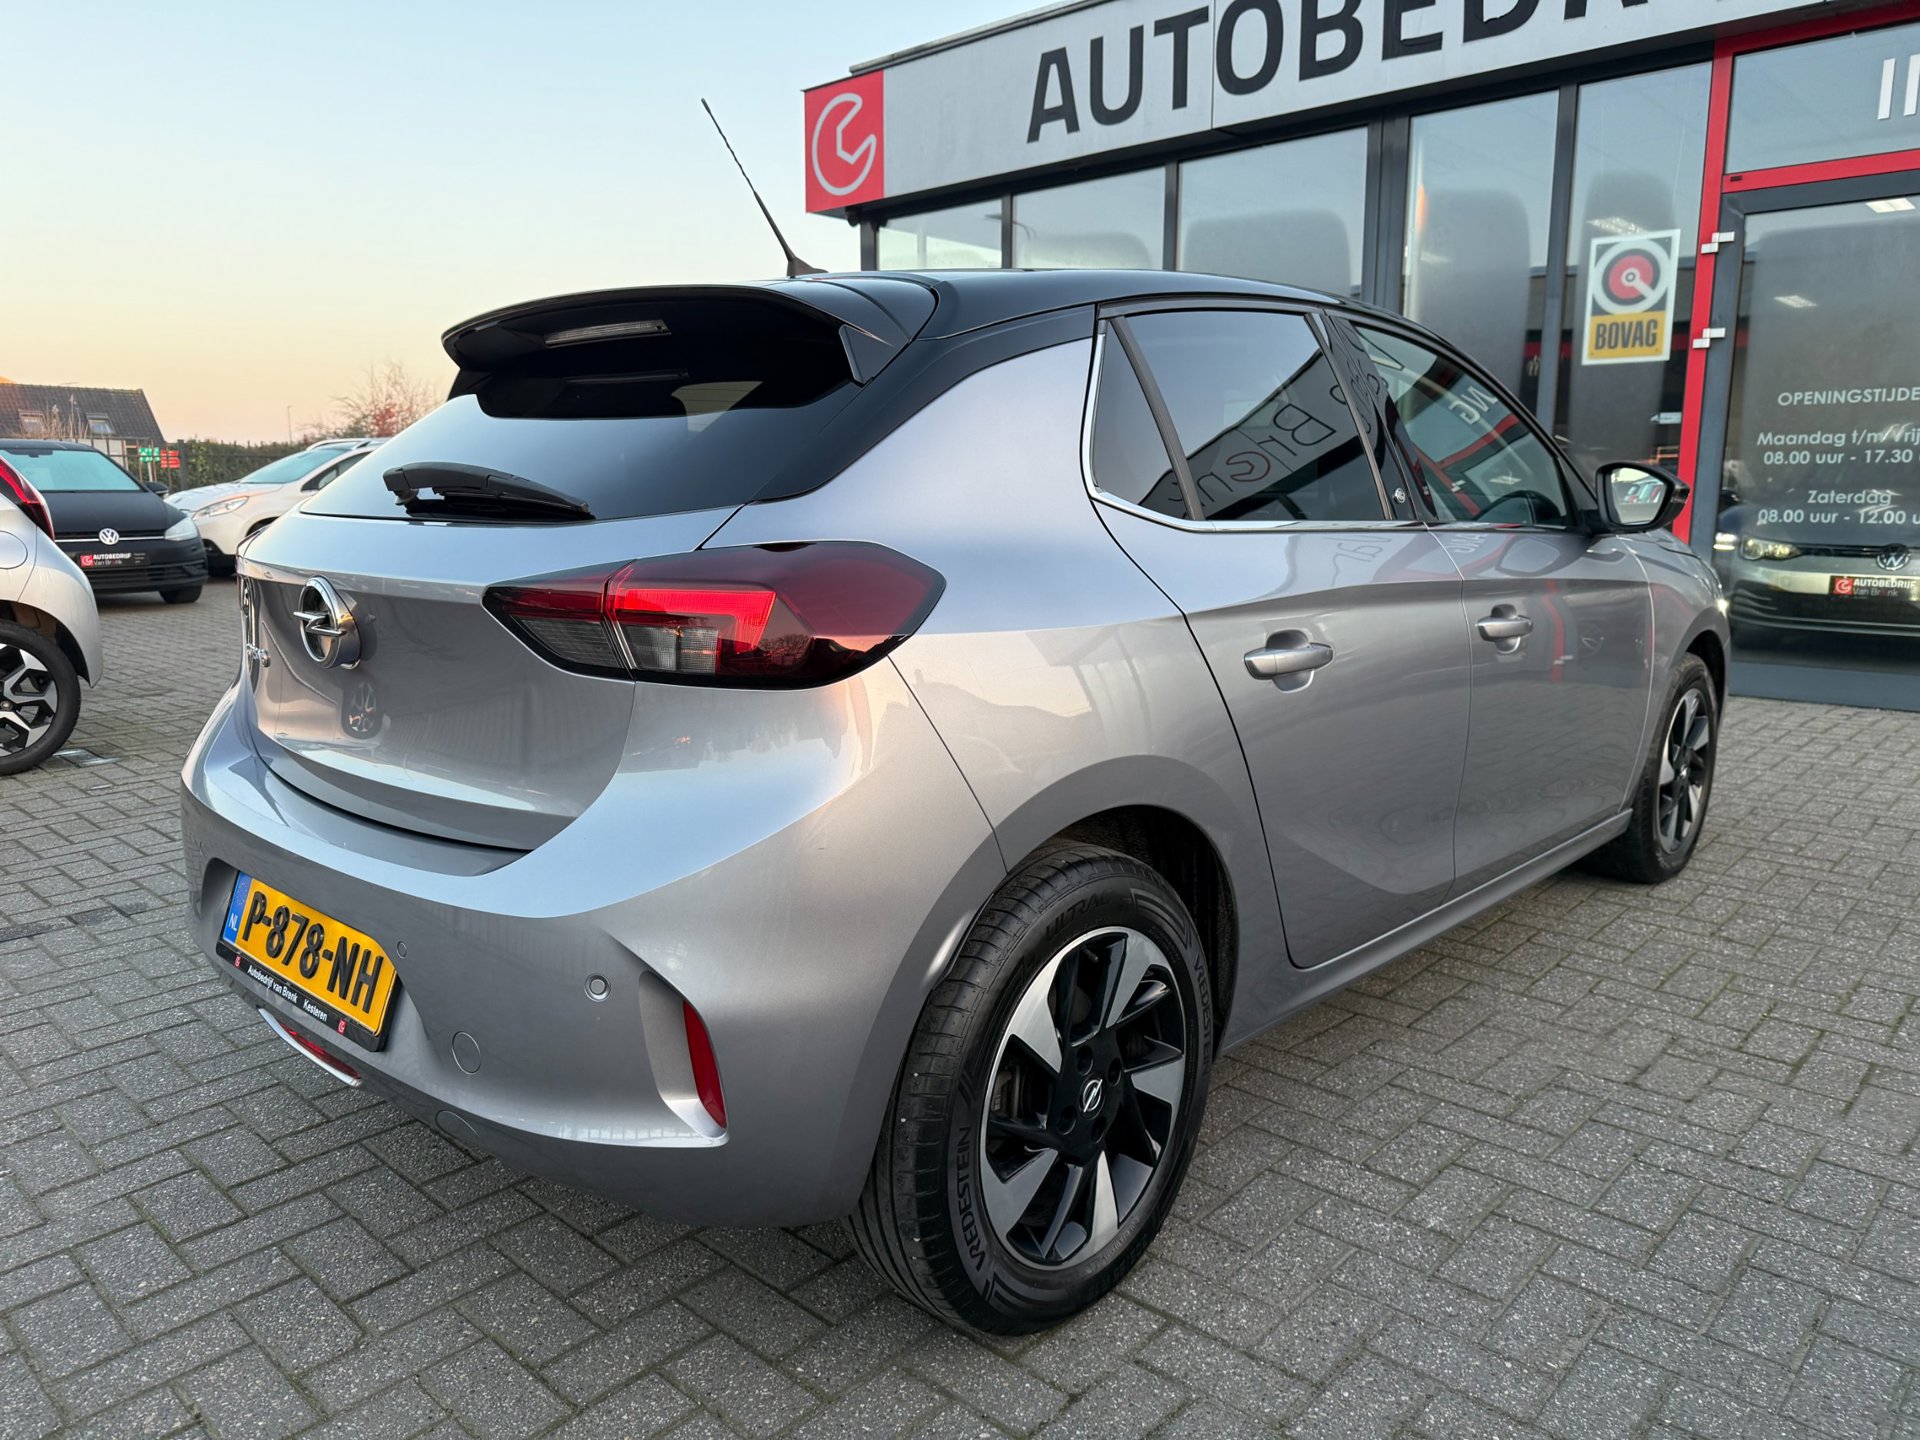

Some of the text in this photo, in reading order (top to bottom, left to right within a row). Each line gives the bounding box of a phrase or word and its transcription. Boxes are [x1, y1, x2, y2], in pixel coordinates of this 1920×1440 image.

[1027, 0, 1649, 144] AUTOBE
[1594, 319, 1659, 350] BOVAG
[1777, 387, 1920, 407] OPENINGSTIJDE
[1757, 431, 1846, 447] Maandag
[1851, 429, 1885, 446] t/m
[1764, 450, 1811, 465] 08.00
[1816, 453, 1845, 464] uur
[1864, 449, 1913, 463] 17.30
[1807, 490, 1892, 507] Zaterdag
[1757, 509, 1804, 524] 08.00
[1810, 512, 1839, 523] uur
[1859, 510, 1906, 524] 12.00
[1853, 578, 1917, 589] AUTOBEDRIJF
[1871, 587, 1898, 597] Brnk
[228, 912, 237, 931] NL
[242, 890, 384, 1014] P-878-NH
[247, 964, 274, 989] Autobedrijf
[272, 982, 282, 994] van
[303, 998, 328, 1022] Kesteren
[956, 1126, 986, 1272] VREDESTEIN
